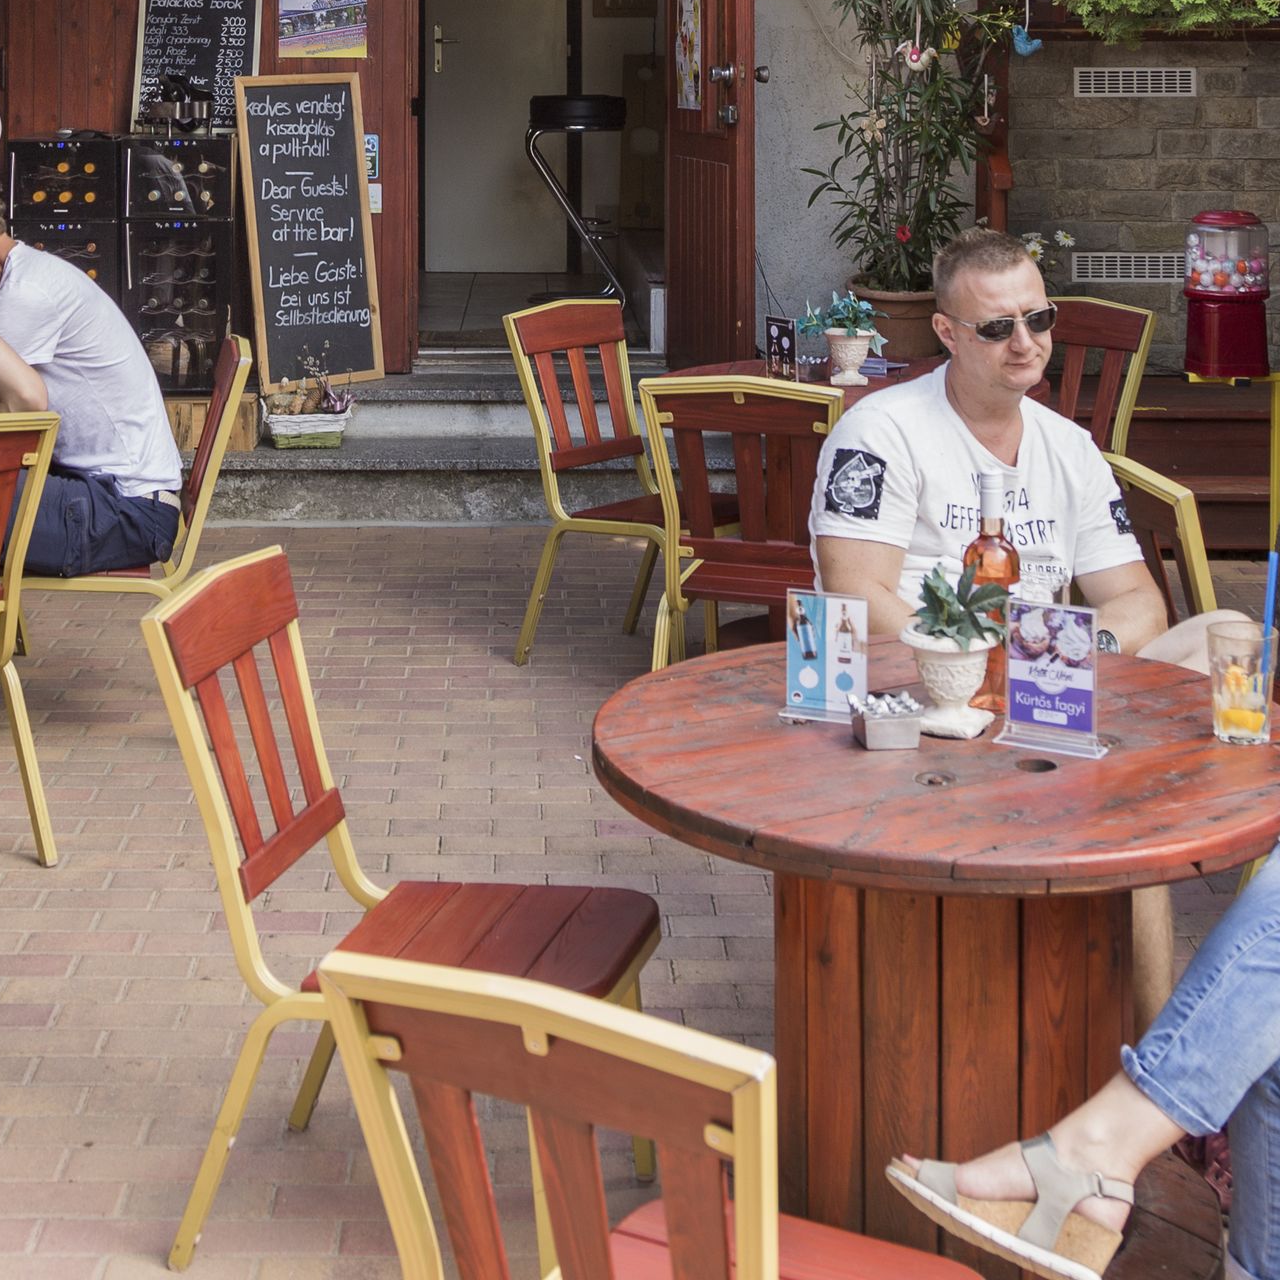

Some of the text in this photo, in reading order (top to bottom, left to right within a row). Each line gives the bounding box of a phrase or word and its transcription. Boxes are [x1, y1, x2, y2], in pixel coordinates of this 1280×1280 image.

[171, 26, 189, 35] 333
[189, 76, 209, 86] Noir
[245, 94, 291, 117] kedves
[266, 117, 335, 144] kiszolgálás
[259, 144, 270, 156] a
[261, 174, 348, 200] Dear Guests!
[270, 204, 324, 222] Service
[272, 217, 354, 242] at the bar!
[268, 265, 310, 288] Liebe
[280, 284, 352, 307] bei uns ist
[1055, 696, 1086, 717] fagyi
